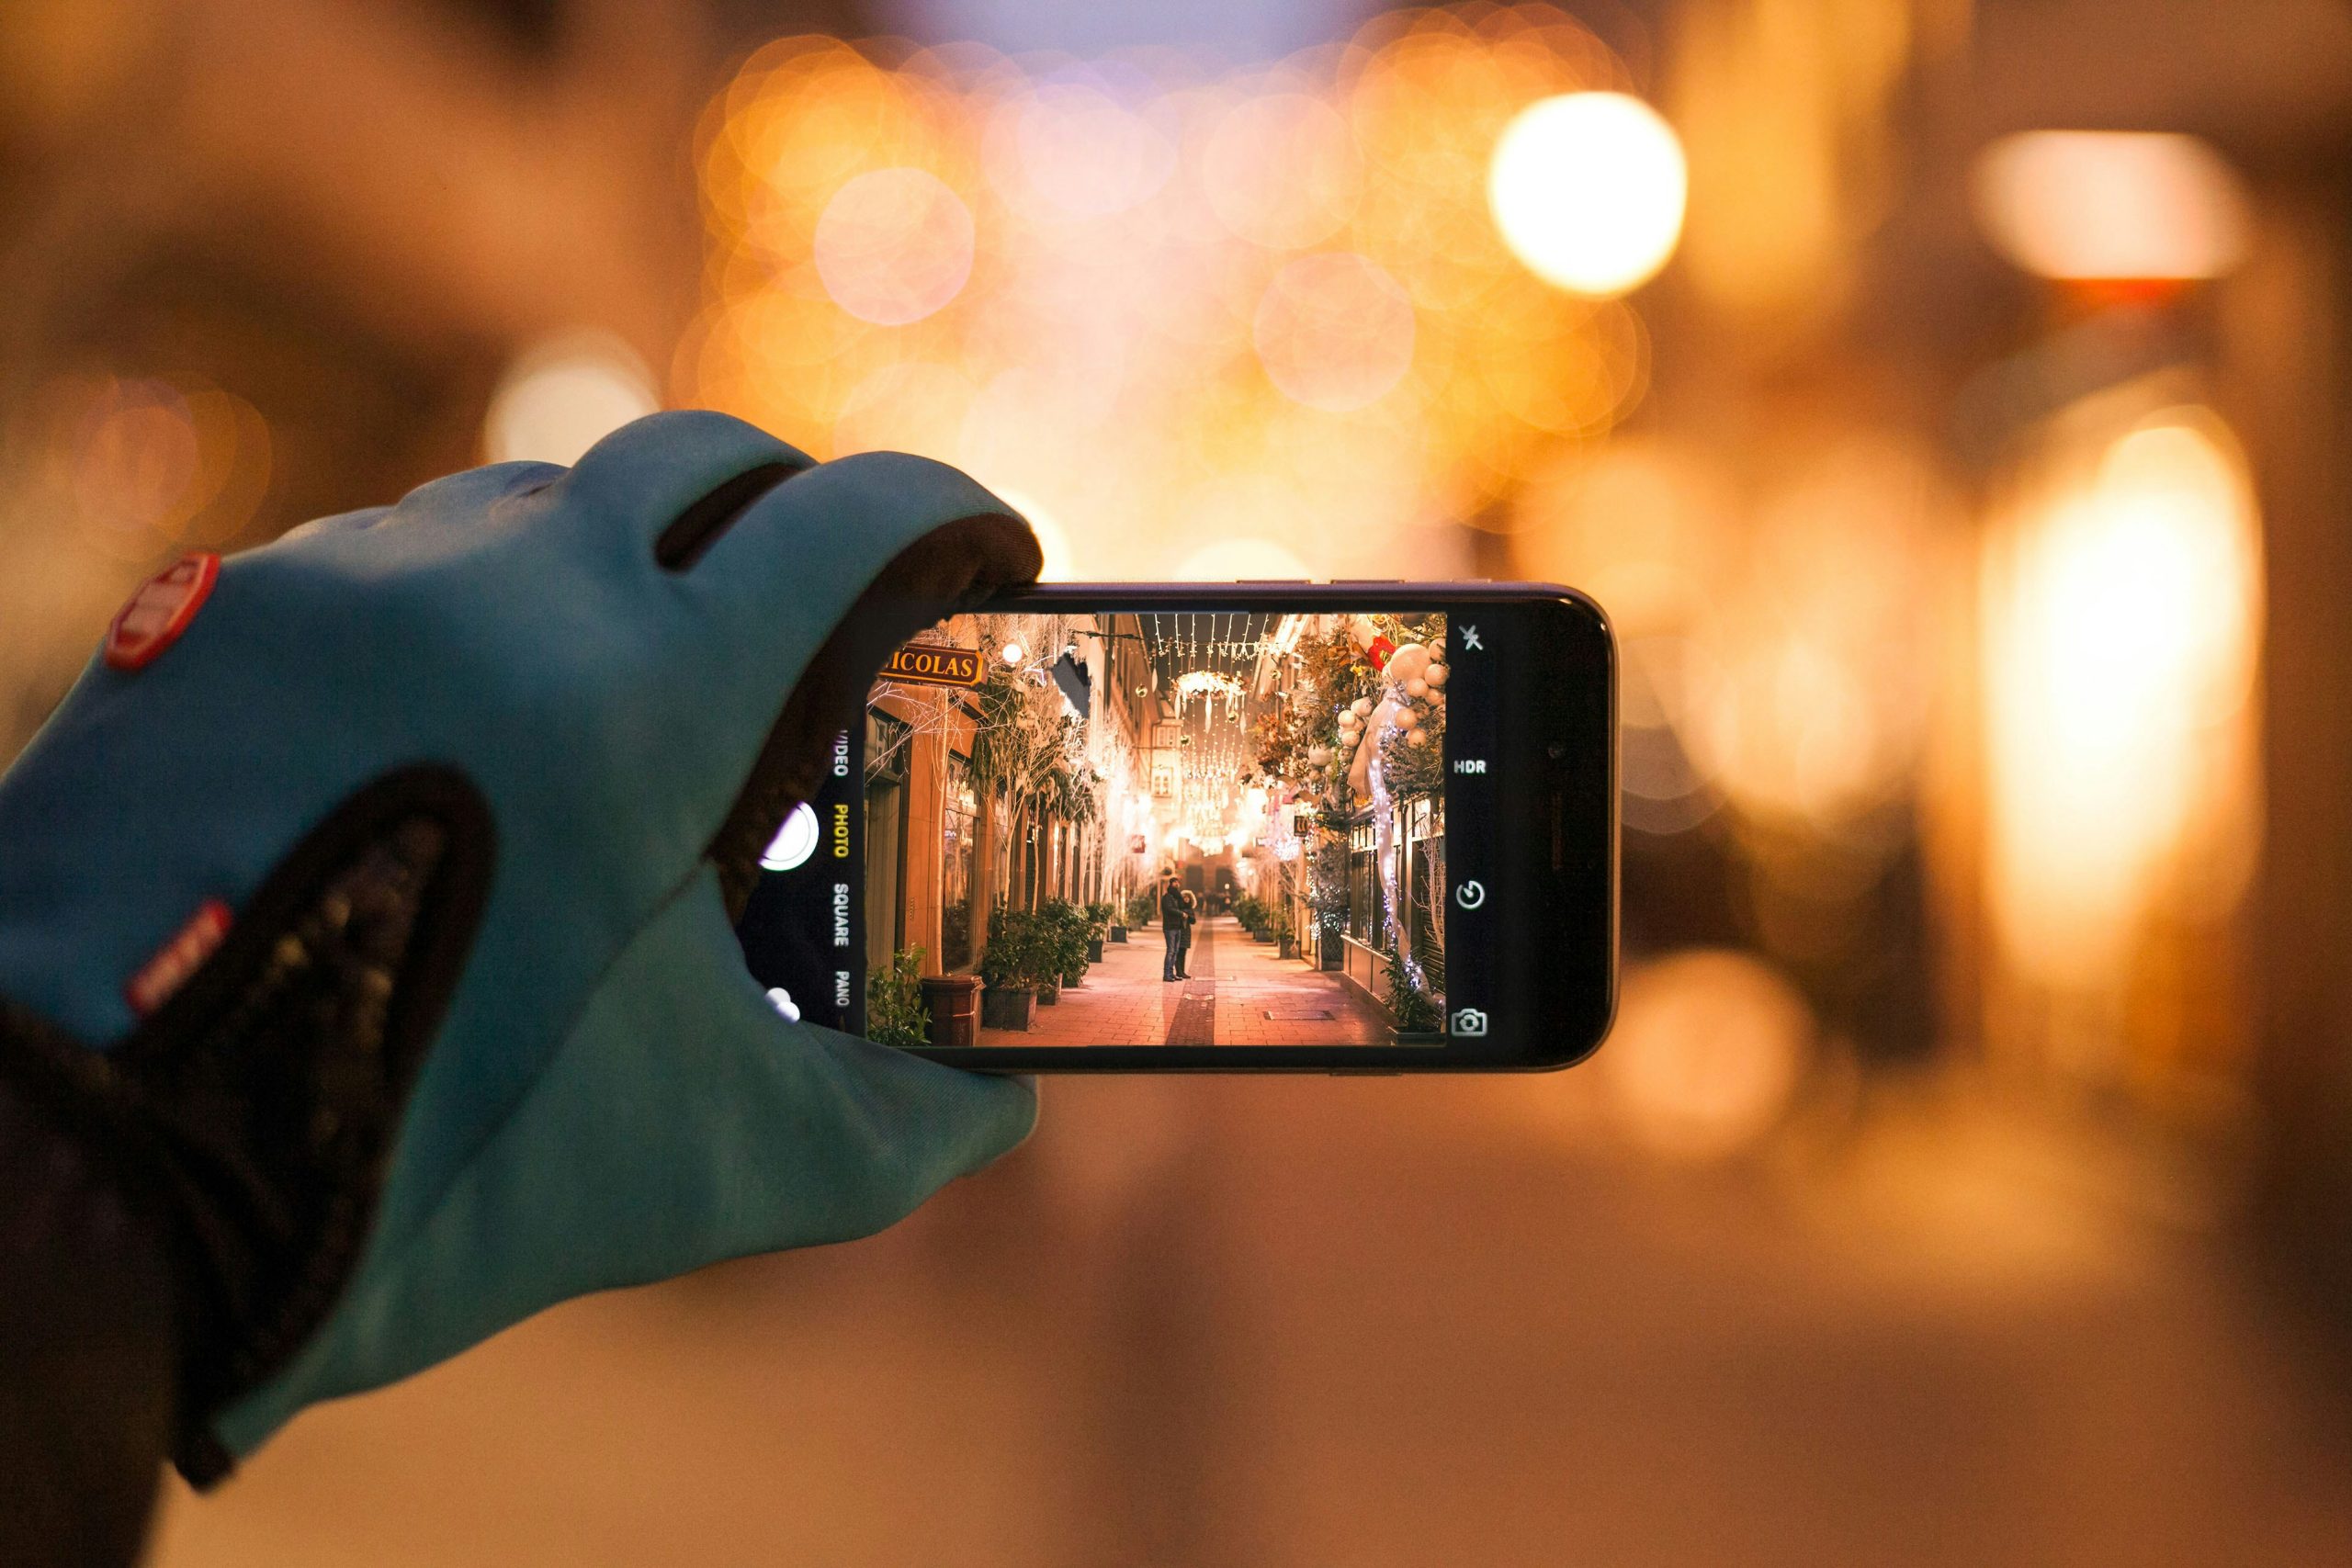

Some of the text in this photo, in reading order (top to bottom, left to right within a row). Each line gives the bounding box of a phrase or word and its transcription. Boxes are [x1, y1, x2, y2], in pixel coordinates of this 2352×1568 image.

[887, 651, 974, 678] ICOLAS
[1453, 760, 1487, 774] HDR
[833, 804, 849, 858] PHOTO
[833, 883, 849, 947] SQUARE
[835, 971, 849, 1007] PANO
